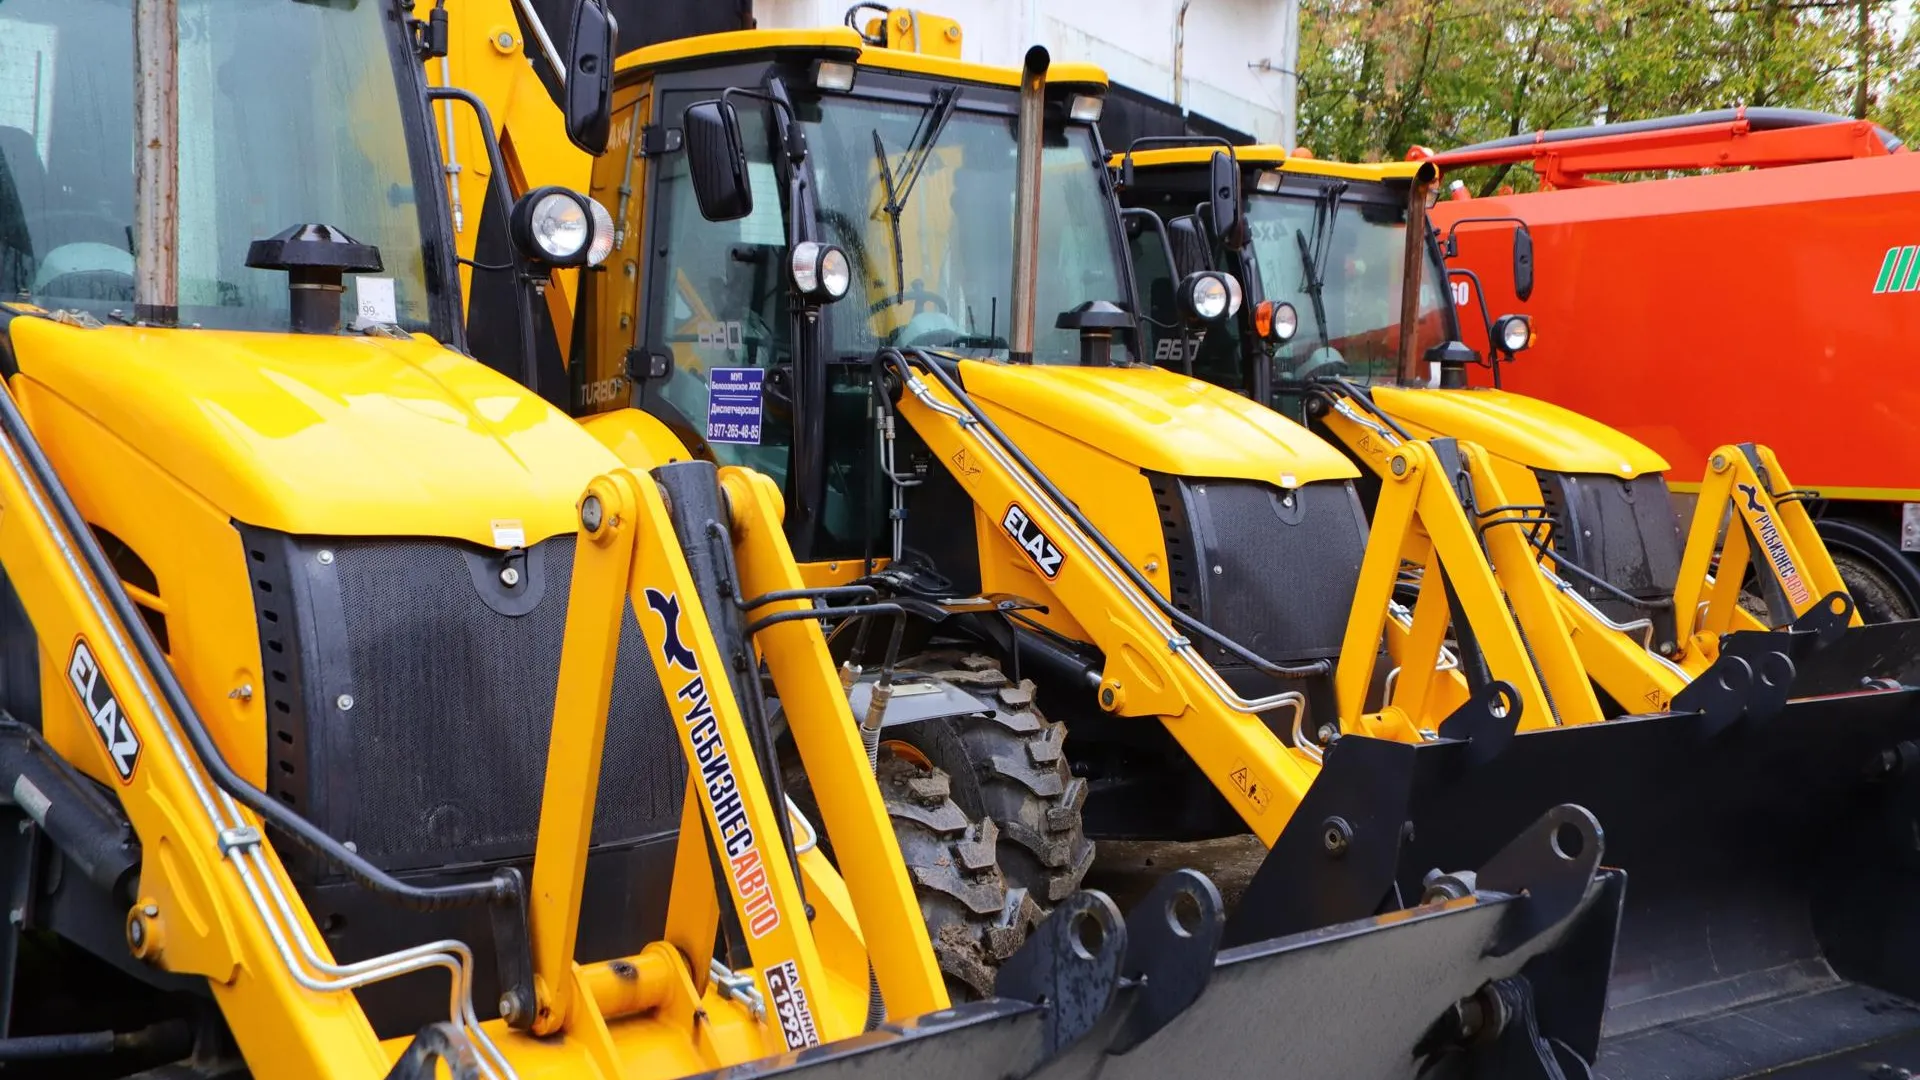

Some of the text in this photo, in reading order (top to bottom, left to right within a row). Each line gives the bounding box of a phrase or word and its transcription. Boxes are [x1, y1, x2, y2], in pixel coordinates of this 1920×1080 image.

[708, 423, 714, 437] 8
[711, 403, 760, 416] Диспетчерская
[1004, 506, 1062, 575] ELAZ
[70, 643, 138, 775] ELAZ
